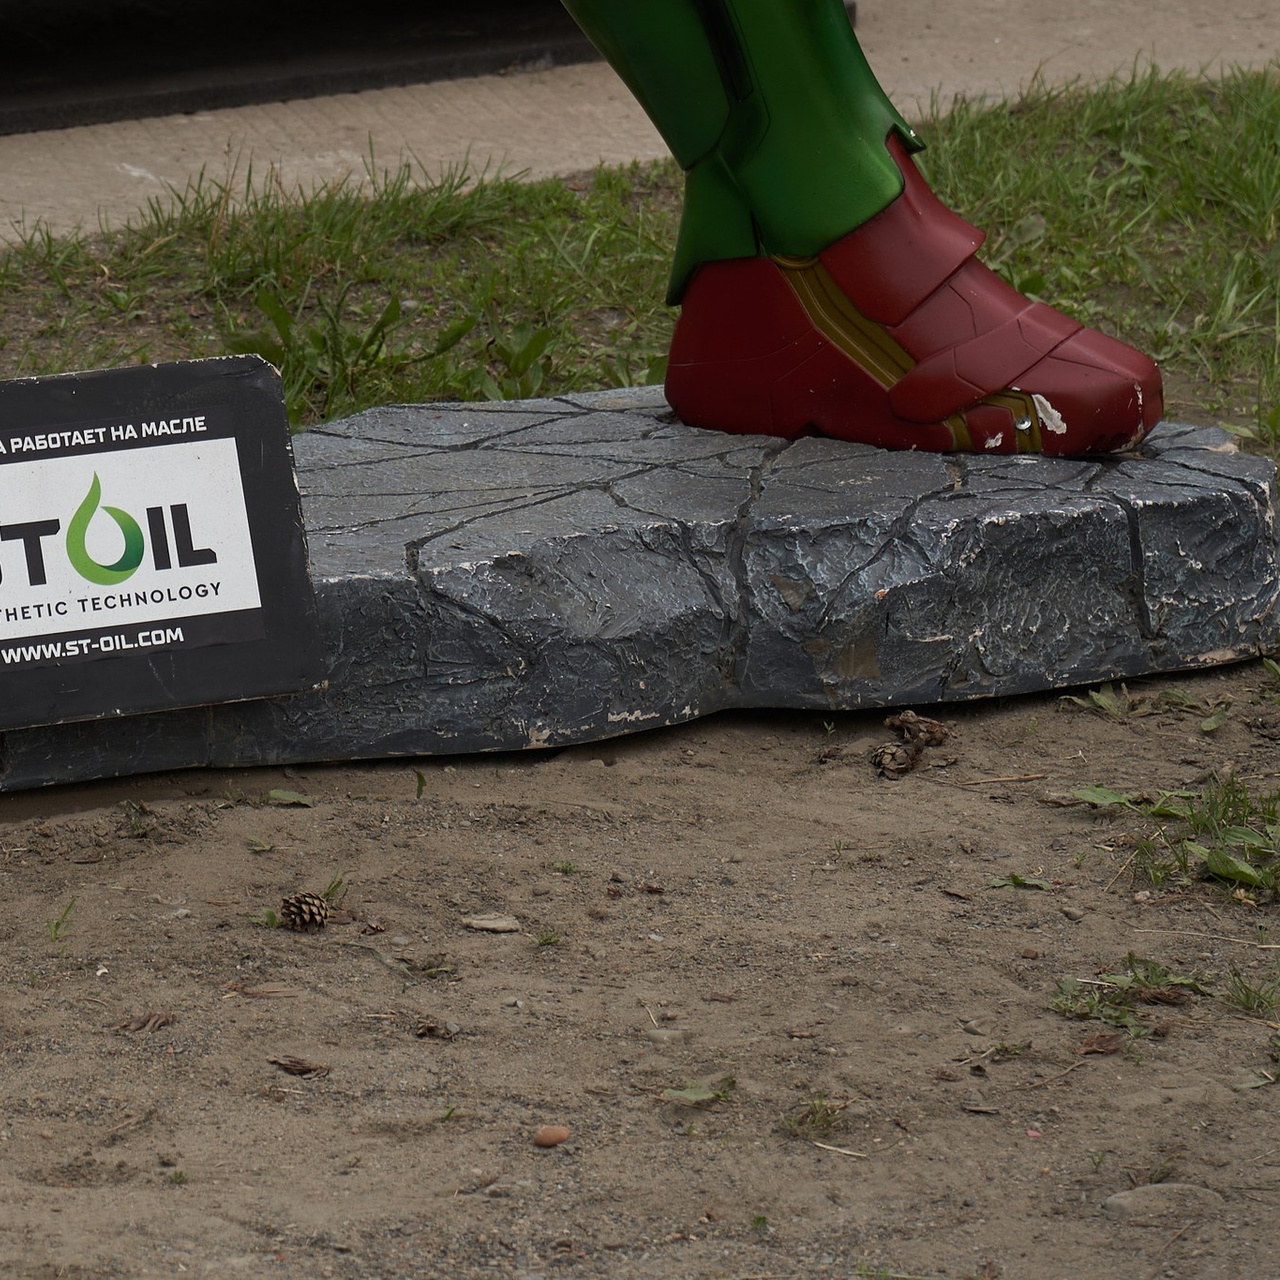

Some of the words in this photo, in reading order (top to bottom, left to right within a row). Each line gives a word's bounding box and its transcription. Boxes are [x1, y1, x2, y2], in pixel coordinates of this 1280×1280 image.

[10, 428, 107, 453] РАБОТАЕТ
[110, 422, 138, 440] НА
[141, 416, 207, 437] МАСЛЕ
[77, 582, 222, 613] TECHNOLOGY
[1, 627, 185, 664] WWW.ST-OIL.COM
